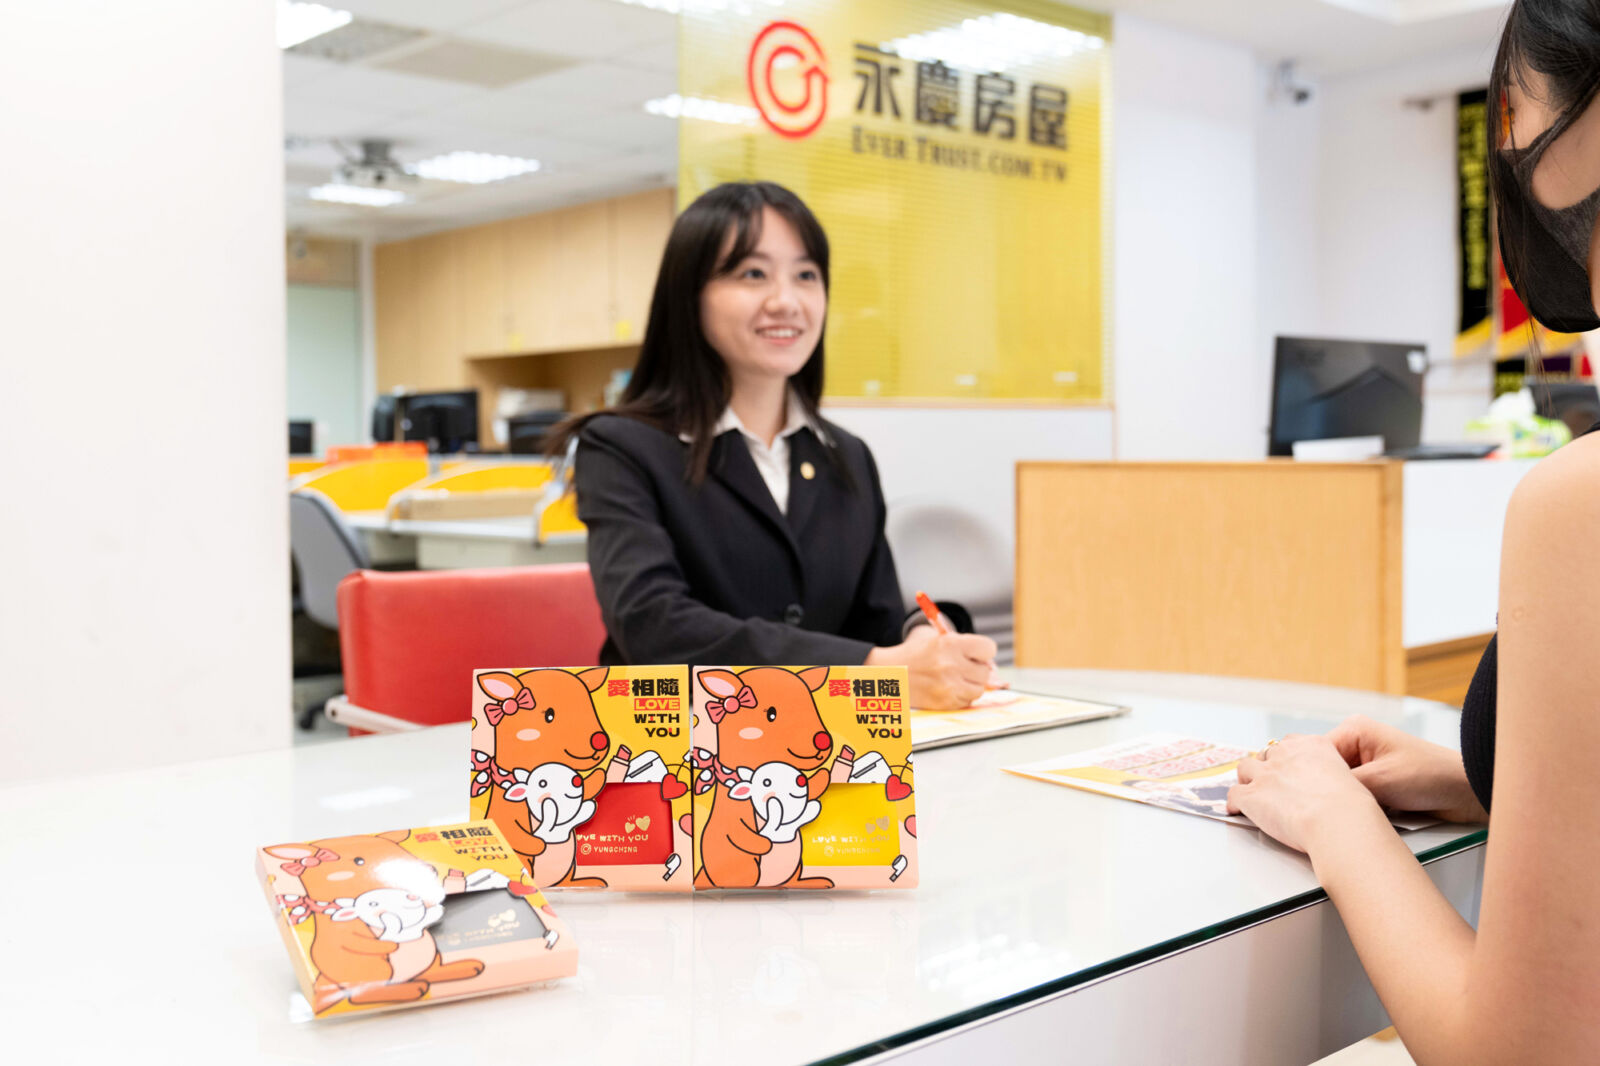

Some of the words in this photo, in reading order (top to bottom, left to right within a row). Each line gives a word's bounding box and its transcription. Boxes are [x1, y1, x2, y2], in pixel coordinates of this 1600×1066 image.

[853, 42, 1068, 150] 永慶房屋
[607, 678, 680, 697] 愛相隨
[828, 679, 901, 697] 愛相隨
[635, 699, 680, 710] LOVE
[856, 700, 901, 711] LOVE
[634, 713, 680, 723] WITH
[856, 714, 902, 724] WITH
[645, 727, 680, 738] YOU
[867, 728, 902, 739] YOU
[628, 834, 649, 842] YOU
